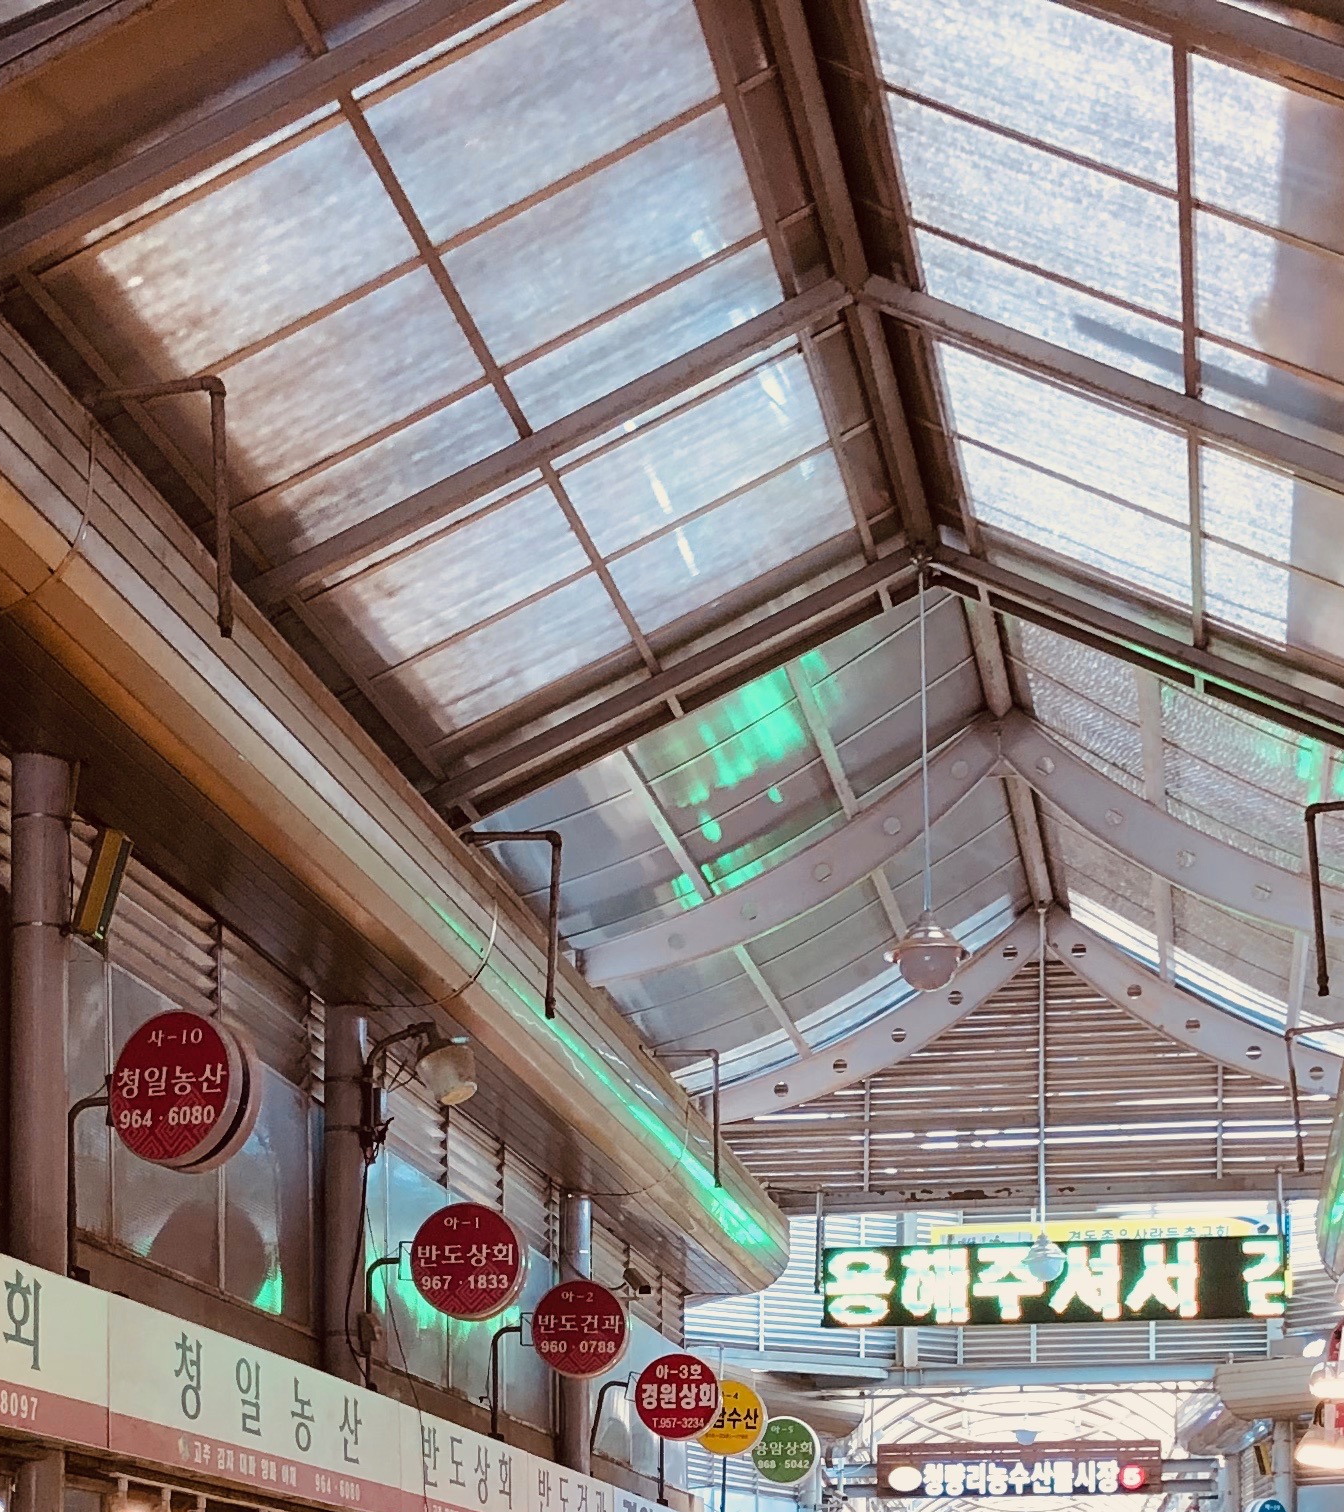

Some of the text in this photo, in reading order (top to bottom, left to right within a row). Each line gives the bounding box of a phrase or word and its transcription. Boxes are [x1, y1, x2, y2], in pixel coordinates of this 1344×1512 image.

[117, 1063, 228, 1100] 청일농산
[417, 1242, 514, 1268] 반도상회
[536, 1313, 623, 1335] 반도건과
[173, 1333, 362, 1465] 청일농산
[641, 1382, 717, 1410] 경원상회
[421, 1424, 513, 1511] 반도상회
[923, 1460, 1120, 1496] 청량리농수산물시장
